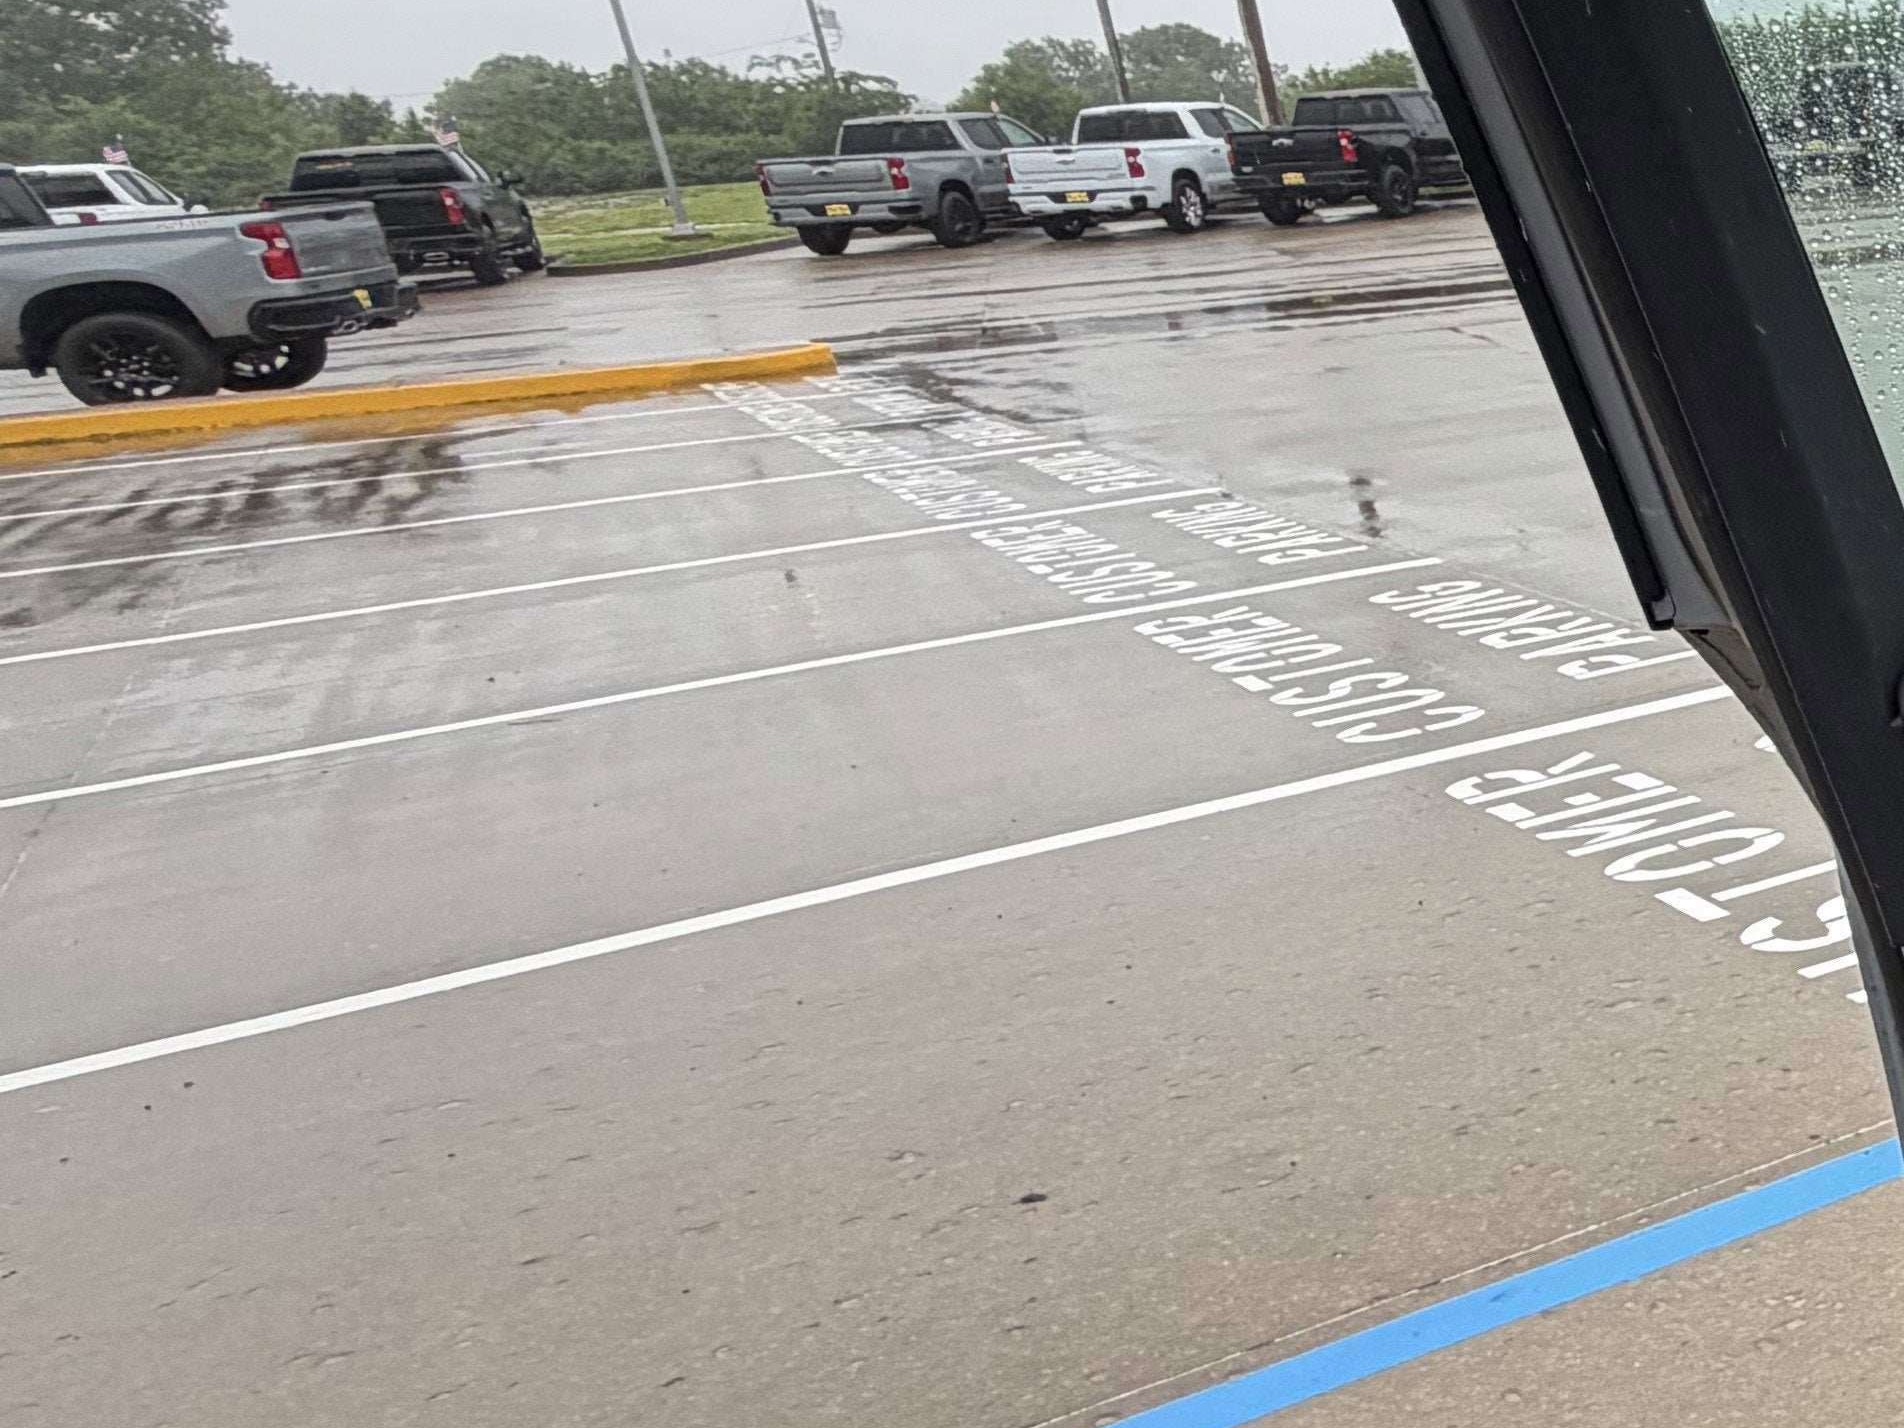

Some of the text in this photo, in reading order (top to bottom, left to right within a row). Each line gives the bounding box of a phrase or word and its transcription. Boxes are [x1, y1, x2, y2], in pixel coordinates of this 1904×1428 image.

[970, 519, 1198, 604] CUSTOMER
[1151, 502, 1368, 565] PARKING
[1134, 605, 1485, 743] CUSTOMER
[1368, 580, 1699, 680] PARKING
[1445, 751, 1868, 1004] STOMER
